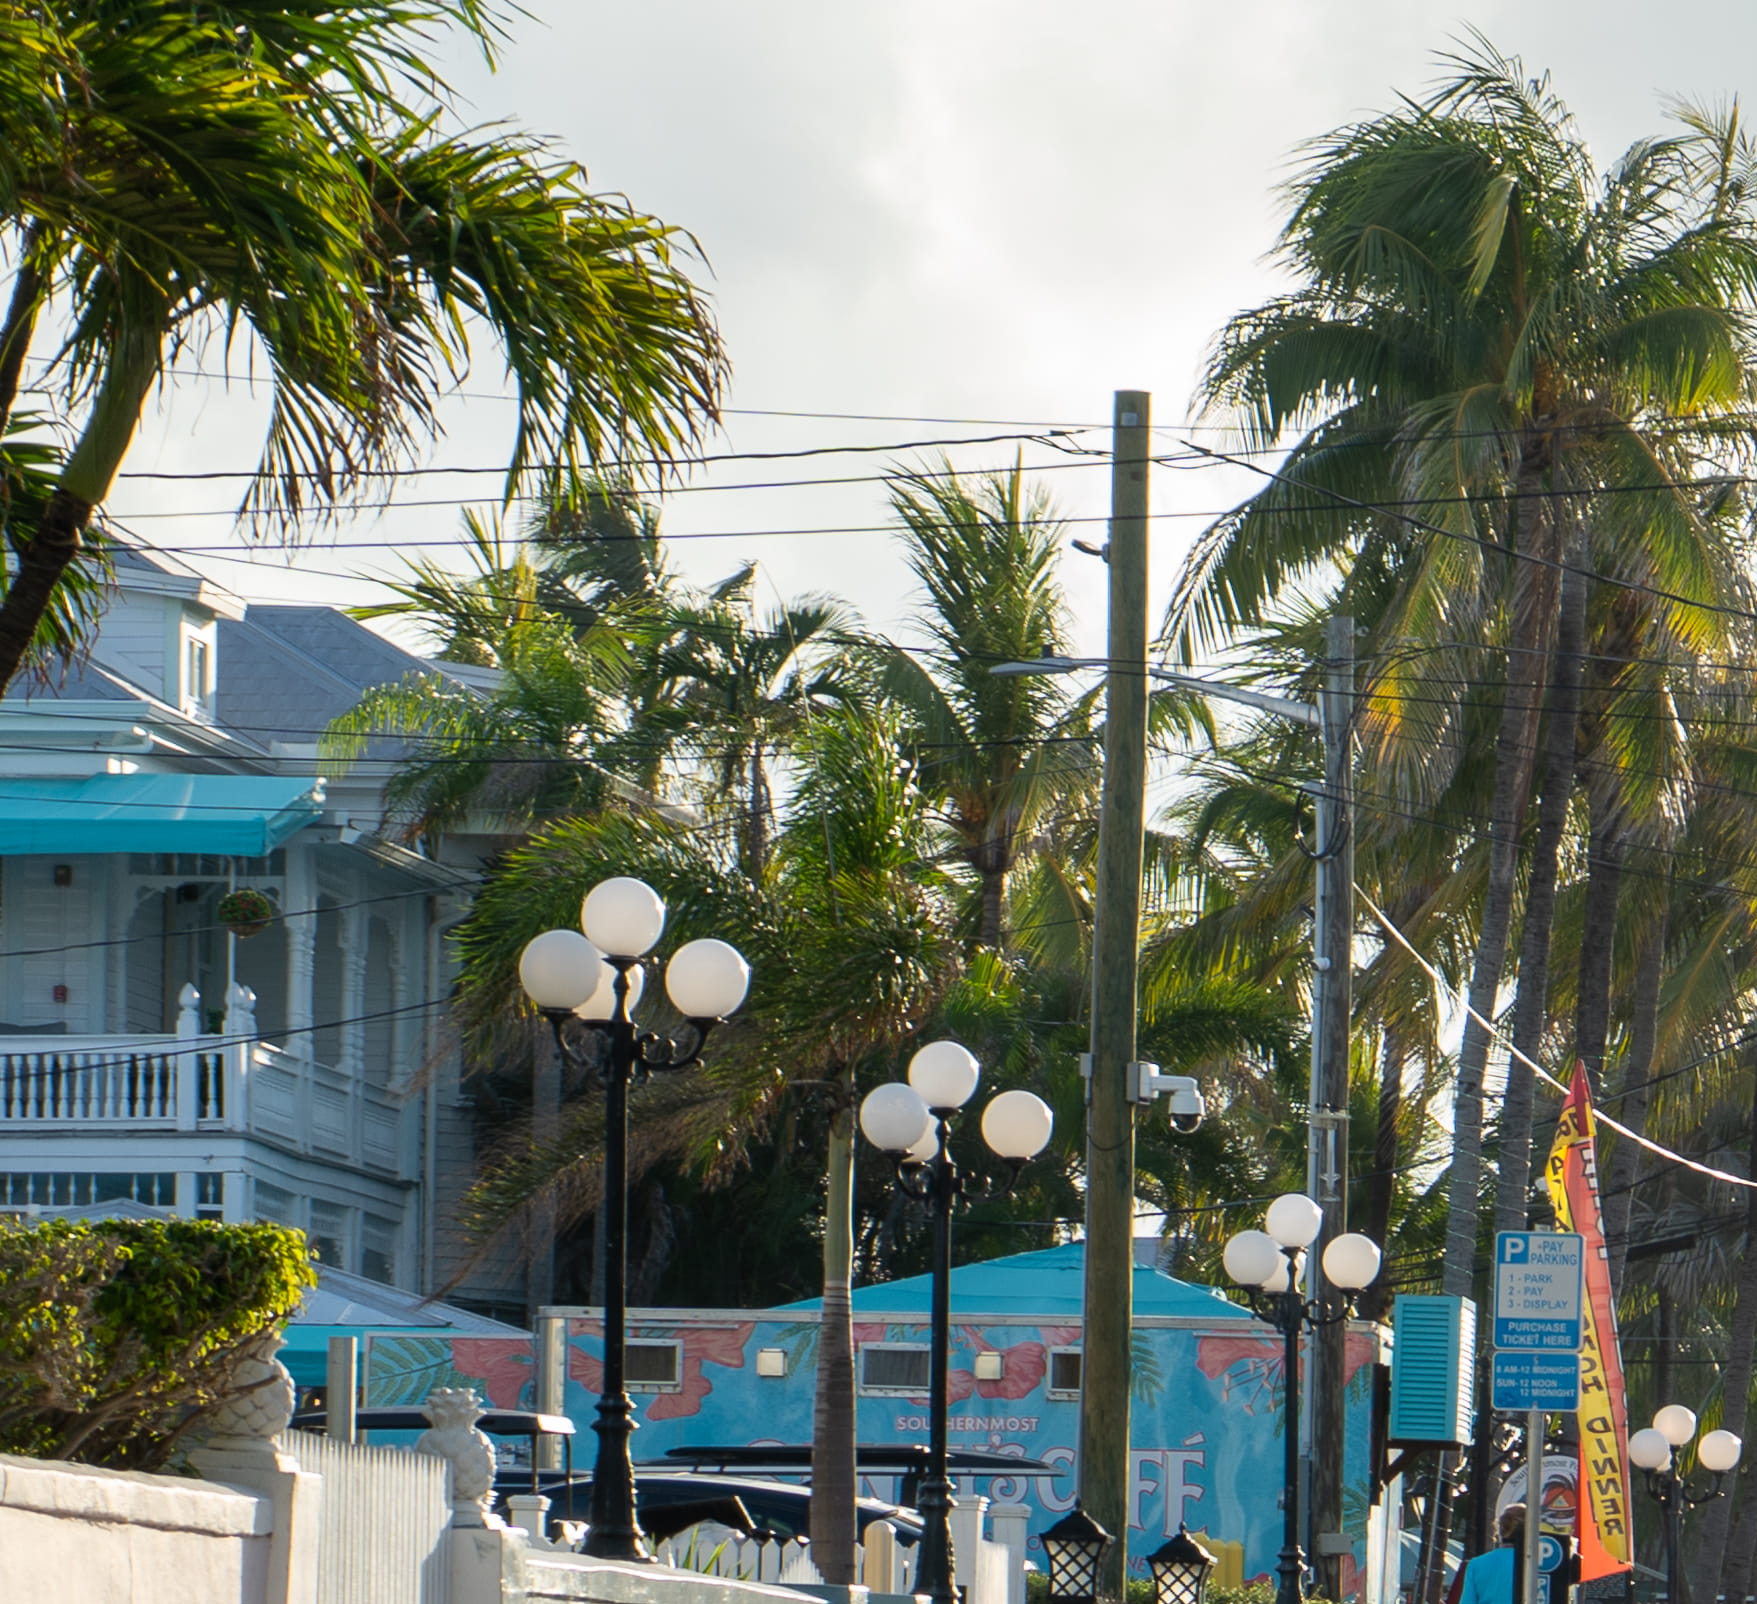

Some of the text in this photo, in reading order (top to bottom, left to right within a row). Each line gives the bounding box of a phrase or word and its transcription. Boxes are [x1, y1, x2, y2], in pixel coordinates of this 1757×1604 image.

[1505, 1237, 1525, 1261] P
[1530, 1253, 1577, 1266] PARKING
[1523, 1273, 1553, 1283] PARK
[1523, 1286, 1544, 1296] PAY
[1522, 1300, 1568, 1310] DISPLAY
[1508, 1322, 1566, 1333] PURCHASE
[1502, 1333, 1572, 1346] TICKET HERE
[1532, 1366, 1576, 1375] MIDNIGHT
[1531, 1379, 1558, 1388] NOON
[1531, 1388, 1575, 1397] MIDNIGHT
[896, 1416, 1040, 1432] SOUHERNMOST
[1036, 1432, 1207, 1539] CFÉ
